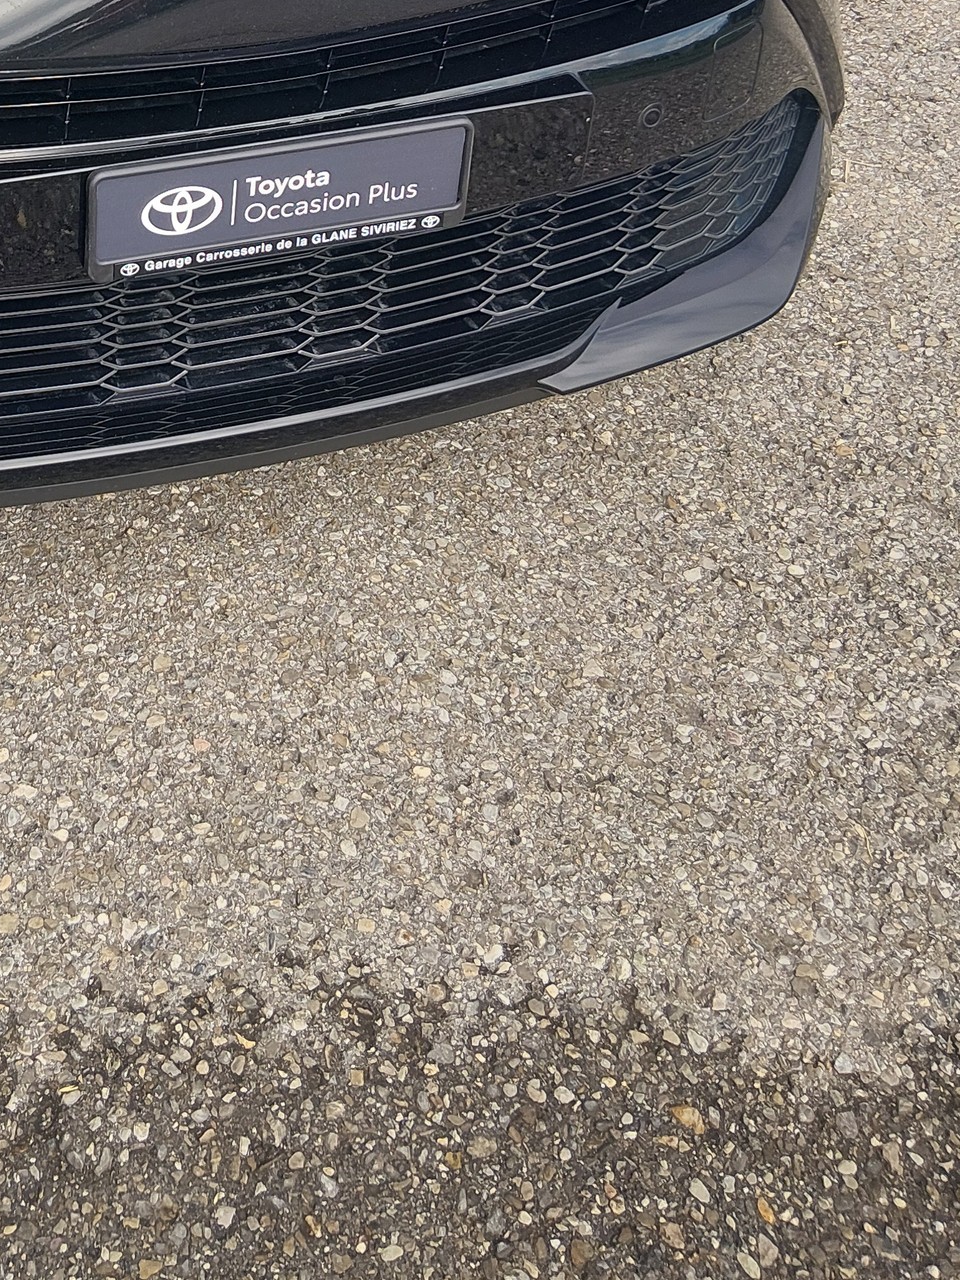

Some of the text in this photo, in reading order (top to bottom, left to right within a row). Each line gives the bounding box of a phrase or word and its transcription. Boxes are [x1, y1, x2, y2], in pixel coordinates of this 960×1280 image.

[243, 181, 419, 224] Occasion Plus
[245, 169, 330, 199] Toyota
[144, 218, 417, 273] Garage Carrosserie de la GLANE SIVIRIEZ
